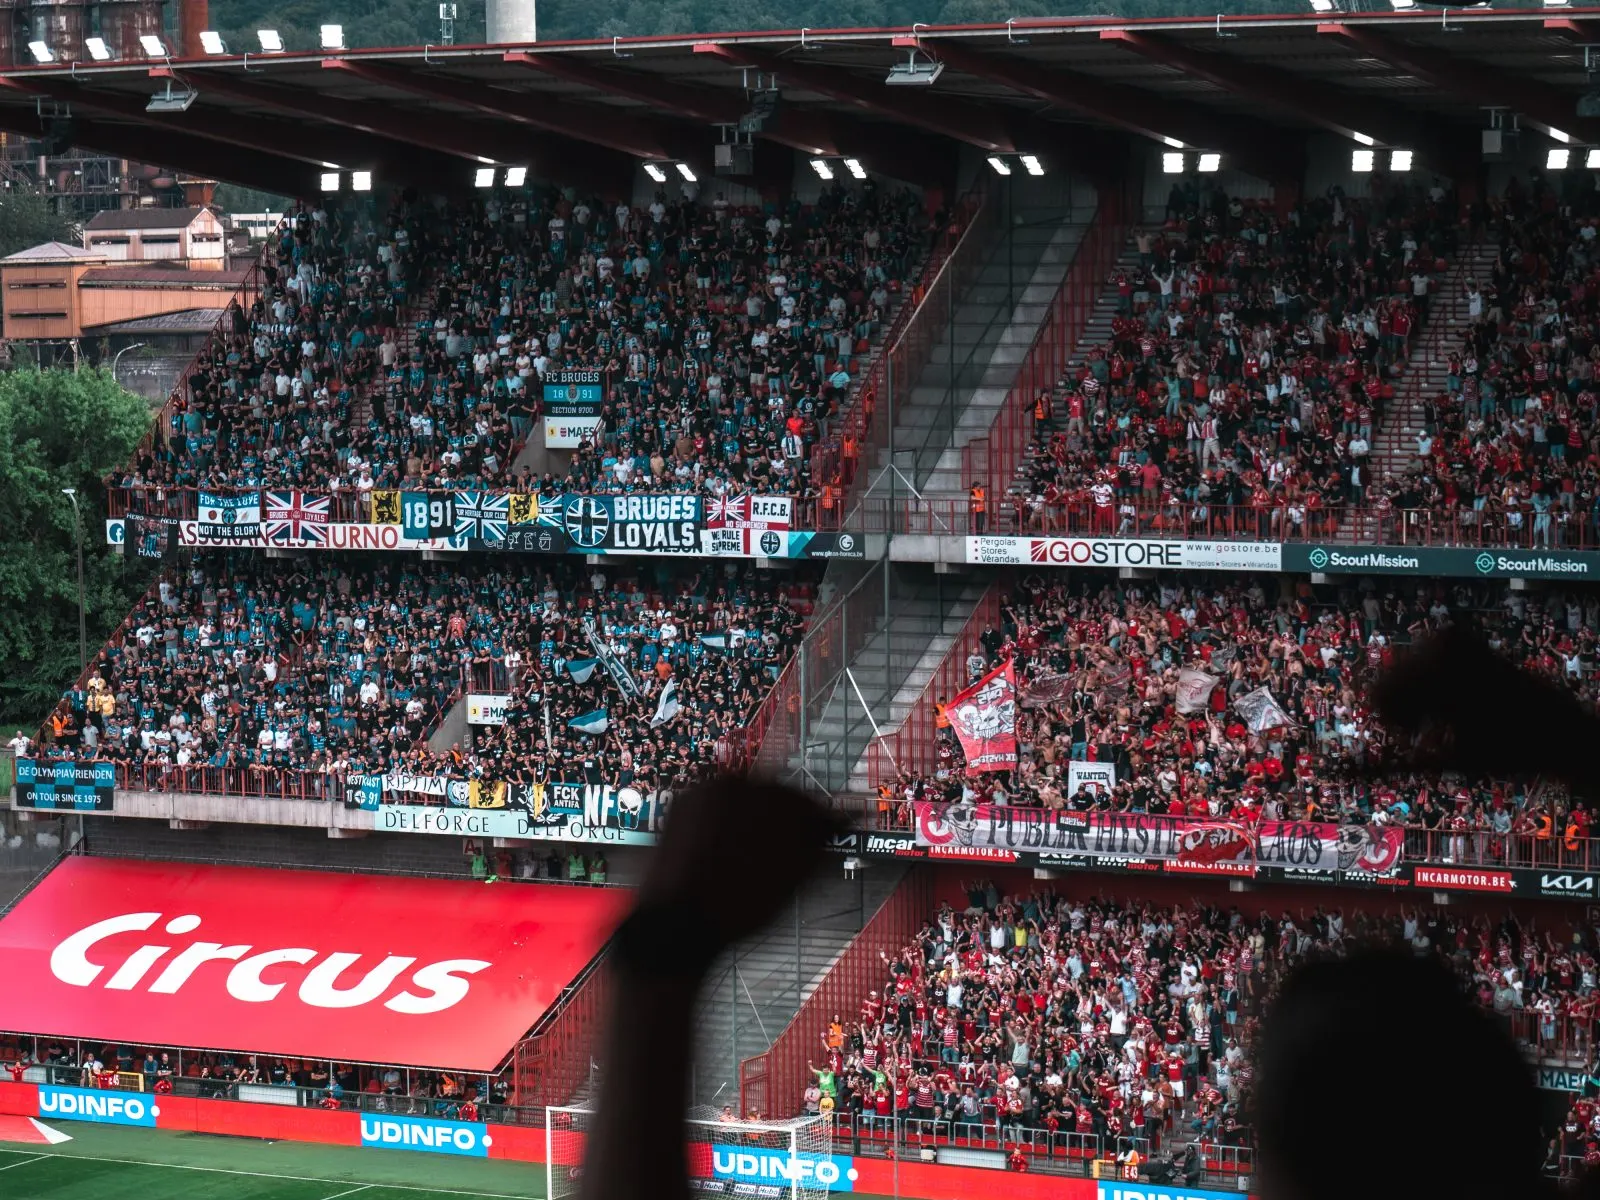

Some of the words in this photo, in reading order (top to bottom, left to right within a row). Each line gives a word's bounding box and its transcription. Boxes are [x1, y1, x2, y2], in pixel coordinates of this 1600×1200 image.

[546, 372, 558, 382] FC
[561, 372, 600, 382] BRUGES
[582, 390, 593, 398] 91
[219, 498, 233, 507] THE
[236, 494, 259, 506] LOVE
[404, 500, 452, 529] 1891
[613, 496, 696, 521] BRUGES
[752, 502, 789, 517] R.F.C.B.
[126, 513, 145, 521] HERO
[160, 517, 178, 525] HELD
[304, 512, 325, 523] LOYALS
[483, 511, 494, 519] OUR
[199, 525, 214, 536] NOT
[217, 526, 232, 536] THE
[234, 525, 259, 536] GLORY
[725, 520, 734, 528] NO
[735, 521, 768, 530] SURRENDER
[613, 522, 695, 548] LOYALS
[721, 529, 740, 541] RULE
[980, 537, 1017, 546] Pergolas
[138, 547, 162, 559] HANS
[980, 547, 1008, 555] Stores
[1049, 541, 1182, 566] GOSTORE
[1186, 543, 1278, 554] www.gostore.be
[981, 555, 1020, 563] Vérandas
[19, 766, 29, 776] DE
[31, 766, 113, 780] OLYMPIAVRIENDEN
[1076, 771, 1109, 780] WANTED
[26, 792, 38, 800] ON
[40, 793, 60, 802] TOUR
[61, 794, 82, 802] SINCE
[84, 795, 101, 804] 1975
[553, 786, 580, 800] FCK
[553, 800, 580, 809] ANTIFA
[584, 783, 616, 827] NF
[385, 811, 490, 833] DELFORGE
[867, 835, 917, 850] incar
[895, 849, 925, 857] motor
[1127, 863, 1160, 871] motor
[1376, 878, 1410, 886] motor
[1417, 872, 1506, 887] INCARMOTOR.BE
[50, 912, 493, 1014] Circus
[39, 1091, 144, 1120] UDINFO
[361, 1120, 476, 1150] UDINFO
[713, 1151, 840, 1184] UDINFO
[1130, 1166, 1138, 1179] 43
